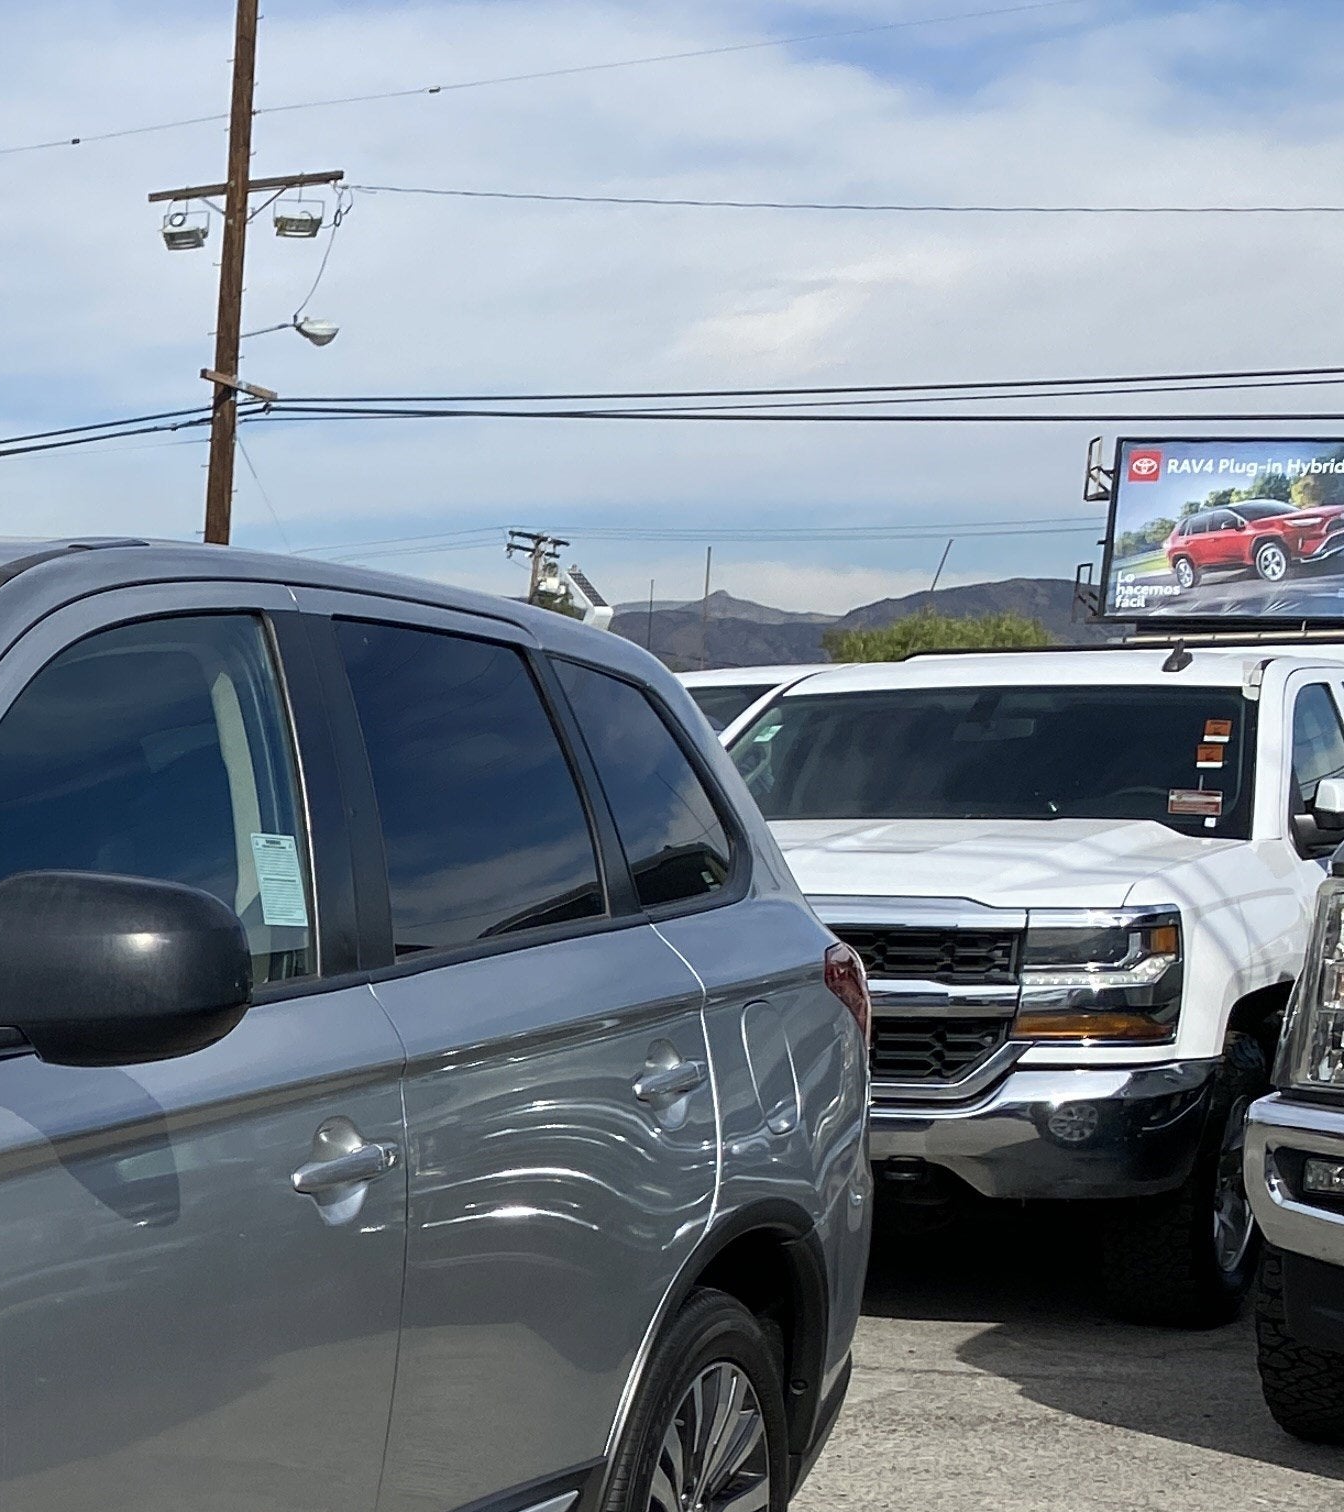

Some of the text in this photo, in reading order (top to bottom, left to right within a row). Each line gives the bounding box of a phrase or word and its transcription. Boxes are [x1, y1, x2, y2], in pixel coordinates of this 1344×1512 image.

[1167, 457, 1344, 478] RAV4 Plug-in Hybrid
[1117, 570, 1136, 583] Lo
[1116, 582, 1181, 596] hacemos
